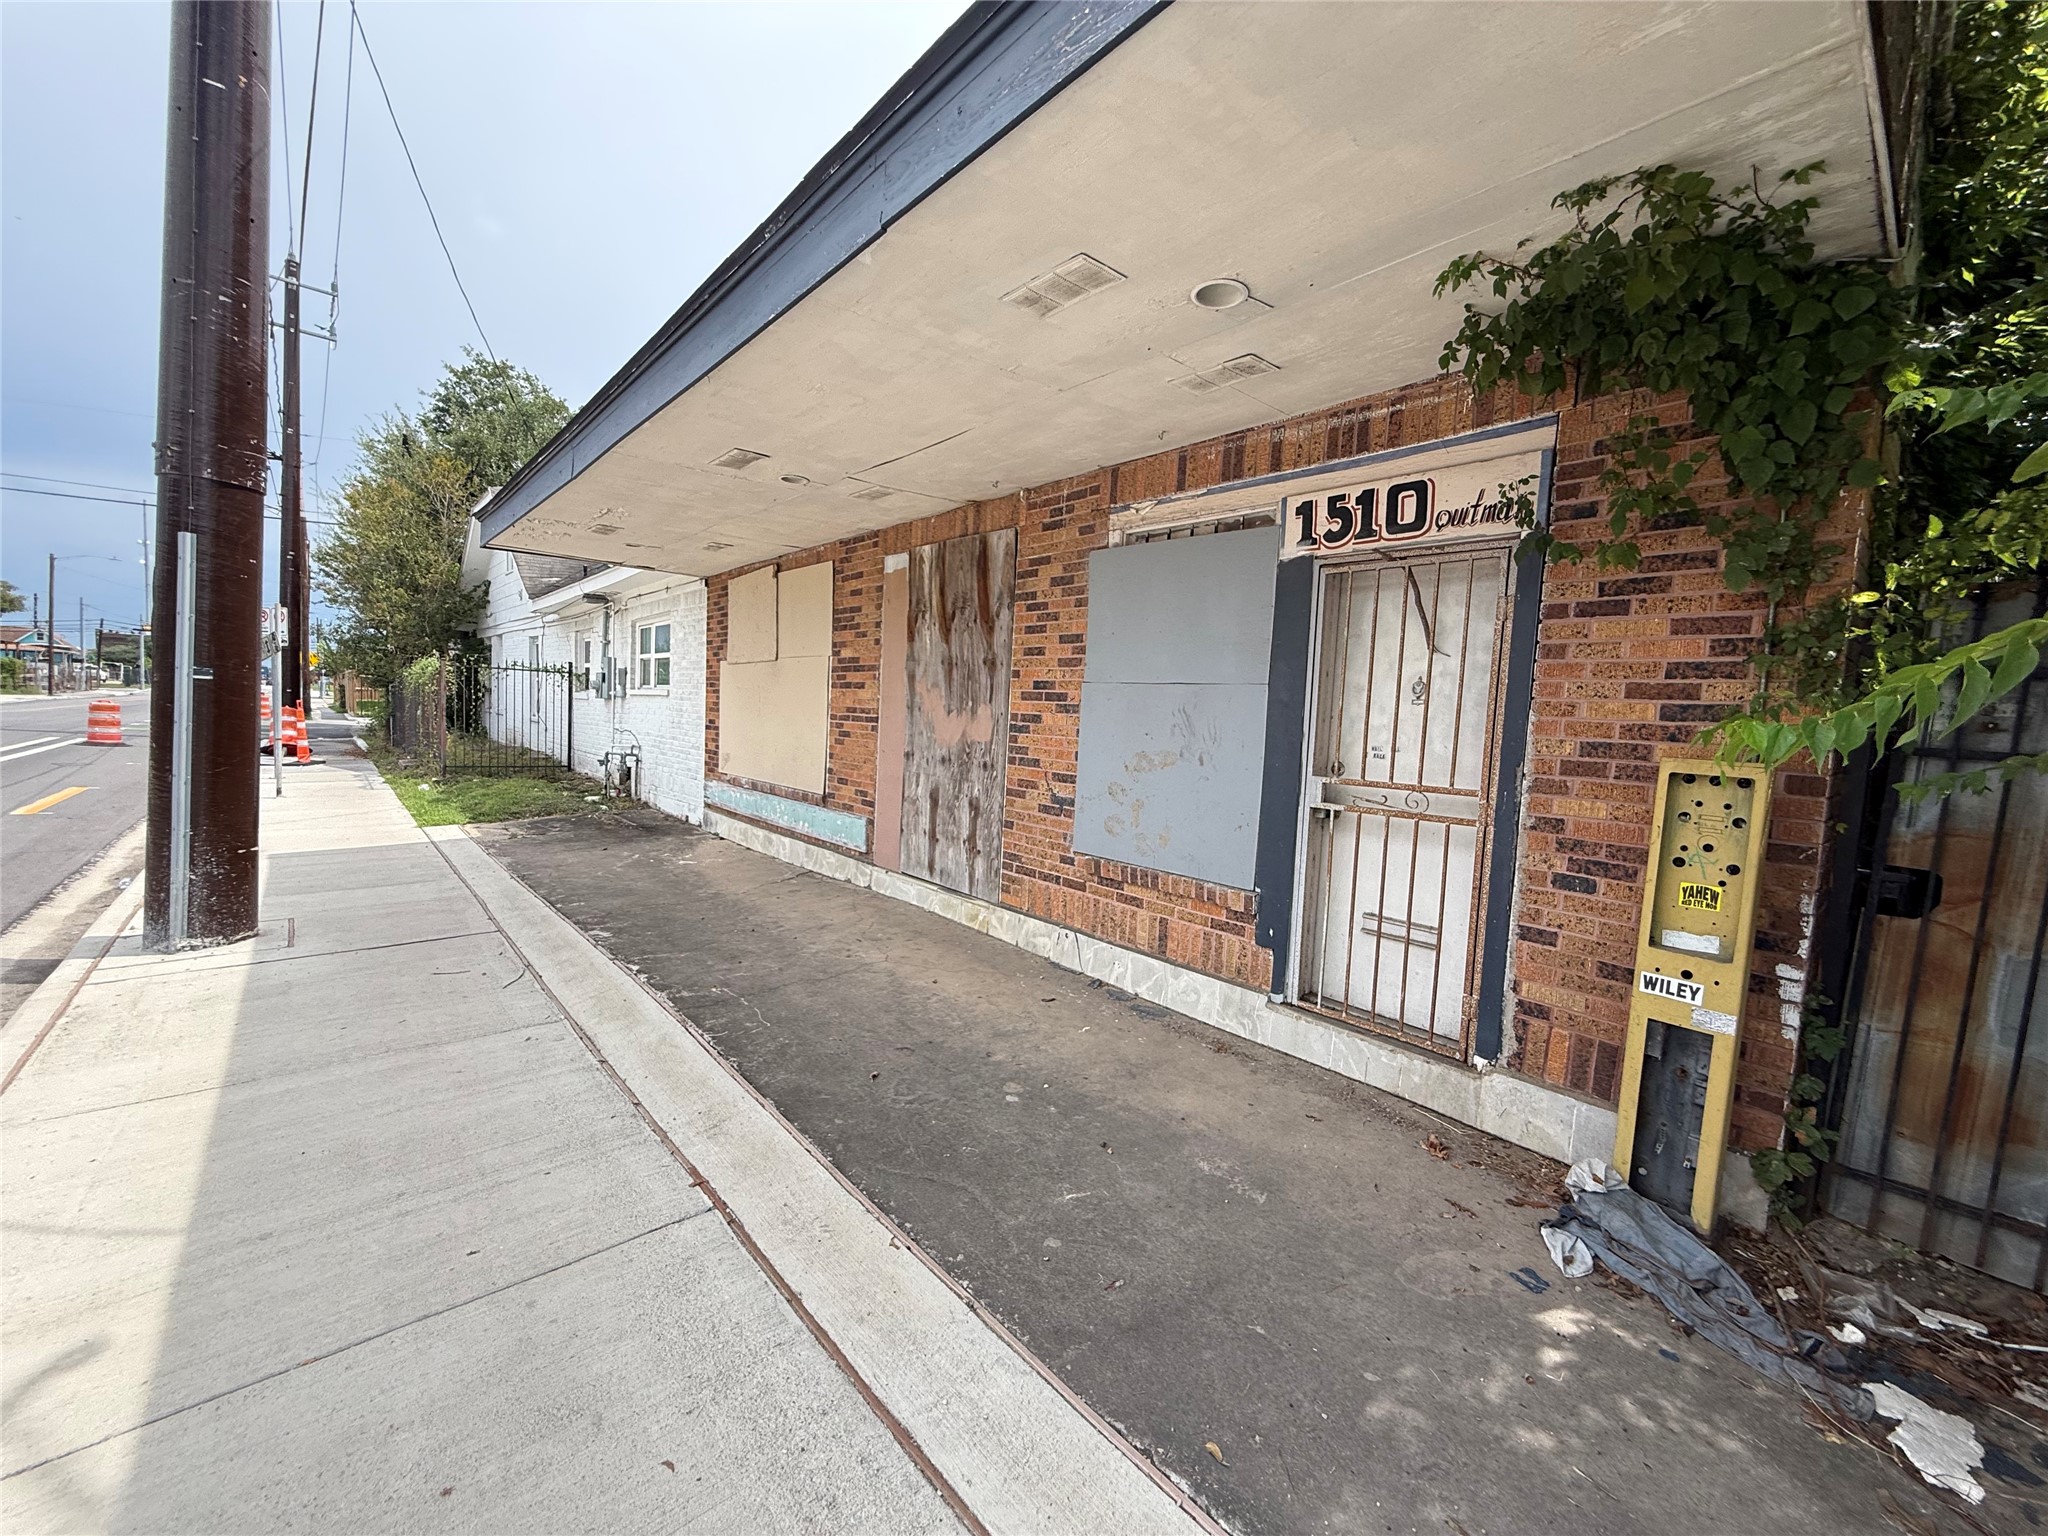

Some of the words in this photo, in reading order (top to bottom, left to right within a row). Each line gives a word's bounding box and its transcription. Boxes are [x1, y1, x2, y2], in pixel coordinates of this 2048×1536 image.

[1295, 478, 1436, 550] 1510
[1434, 488, 1530, 532] Quitma
[1682, 885, 1720, 905] YAHEW
[1693, 899, 1705, 908] EYE
[1643, 974, 1701, 1001] WILEY
